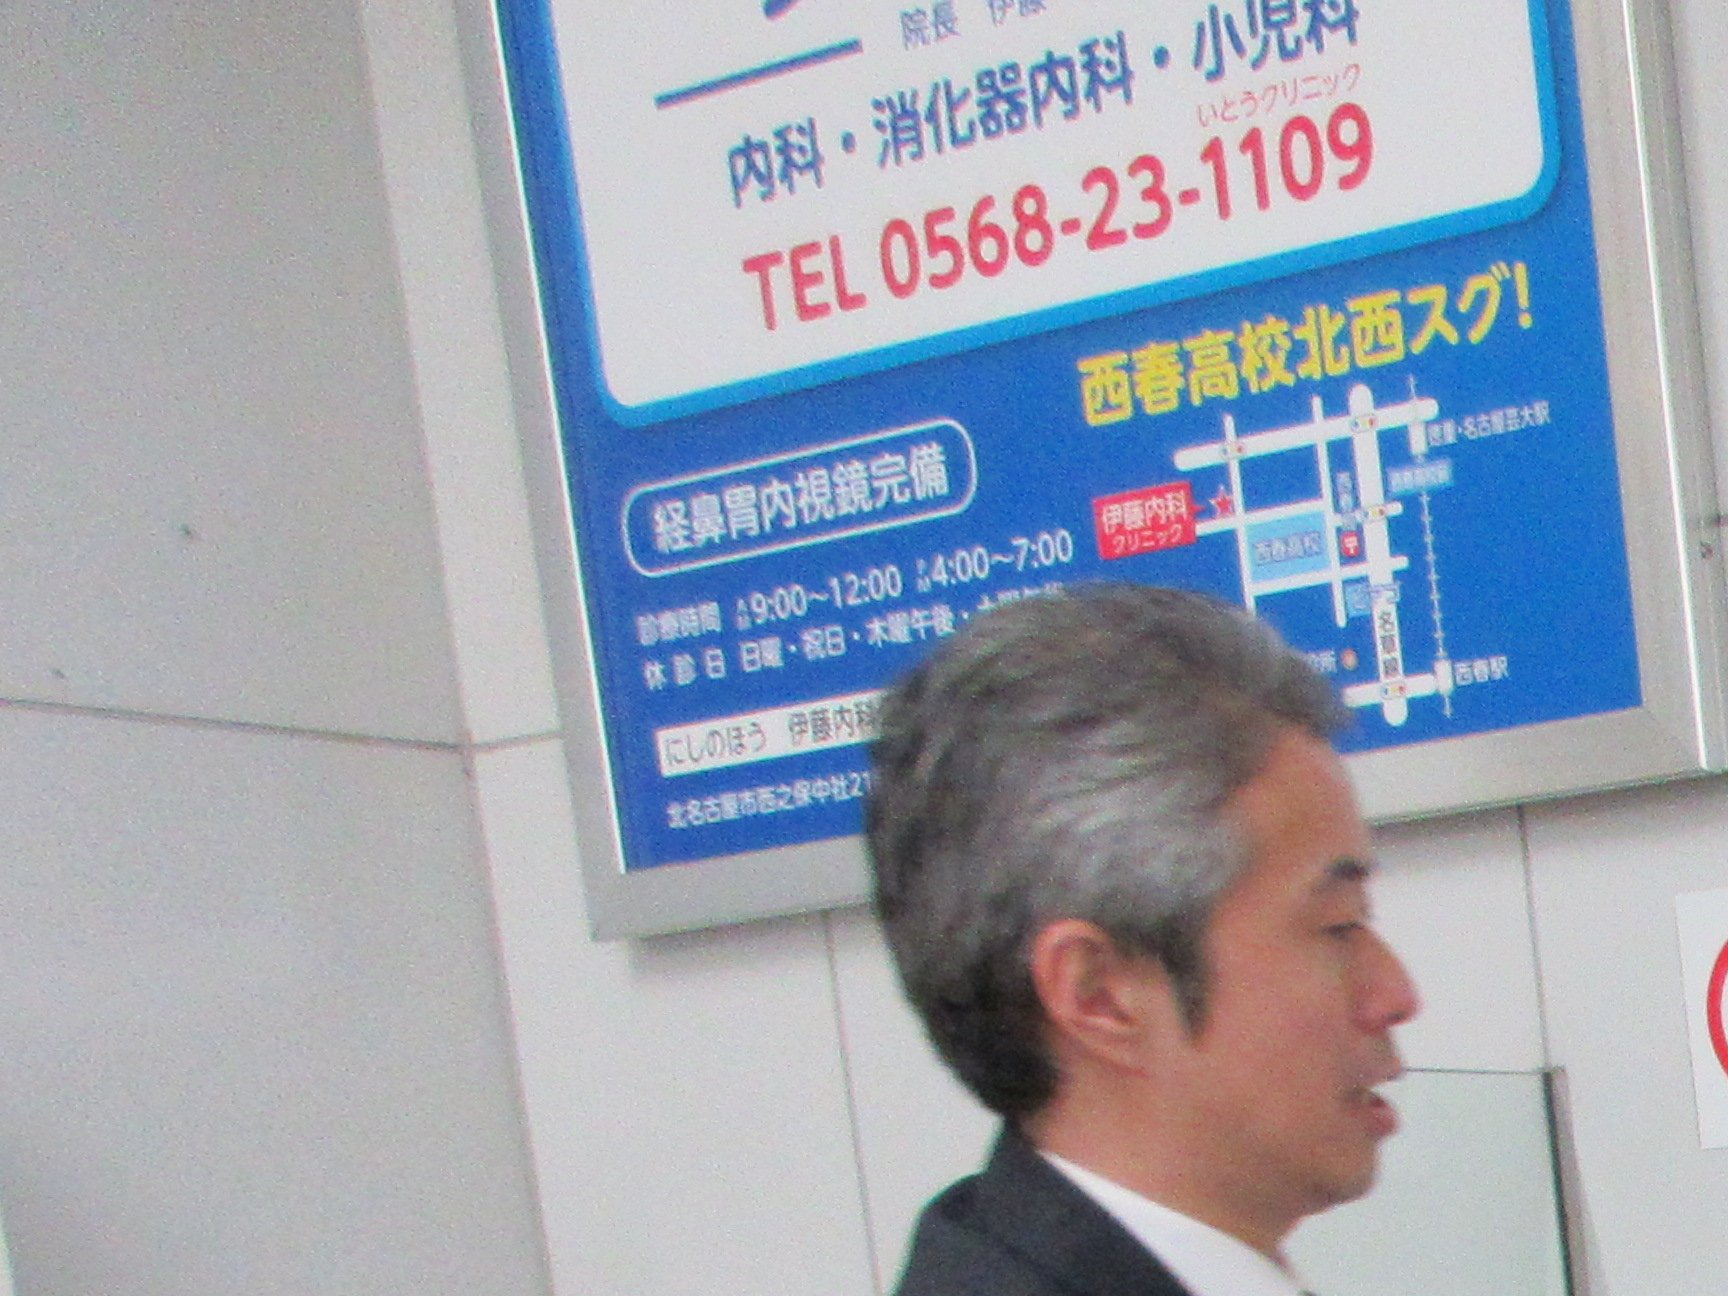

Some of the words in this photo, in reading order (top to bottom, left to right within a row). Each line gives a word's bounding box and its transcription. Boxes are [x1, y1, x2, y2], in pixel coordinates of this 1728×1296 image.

[1196, 64, 1363, 128] いとうクリニック
[742, 234, 867, 331] TEL
[879, 102, 1374, 301] 0568-23-1109
[1077, 261, 1533, 427] 西春高校北西スグ!
[652, 442, 950, 554] 経鼻胃内視鏡完備
[1102, 489, 1188, 535] 伊藤内科
[1112, 523, 1183, 554] クリニック
[636, 601, 722, 647] 診療時間
[664, 720, 767, 767] にしのほう
